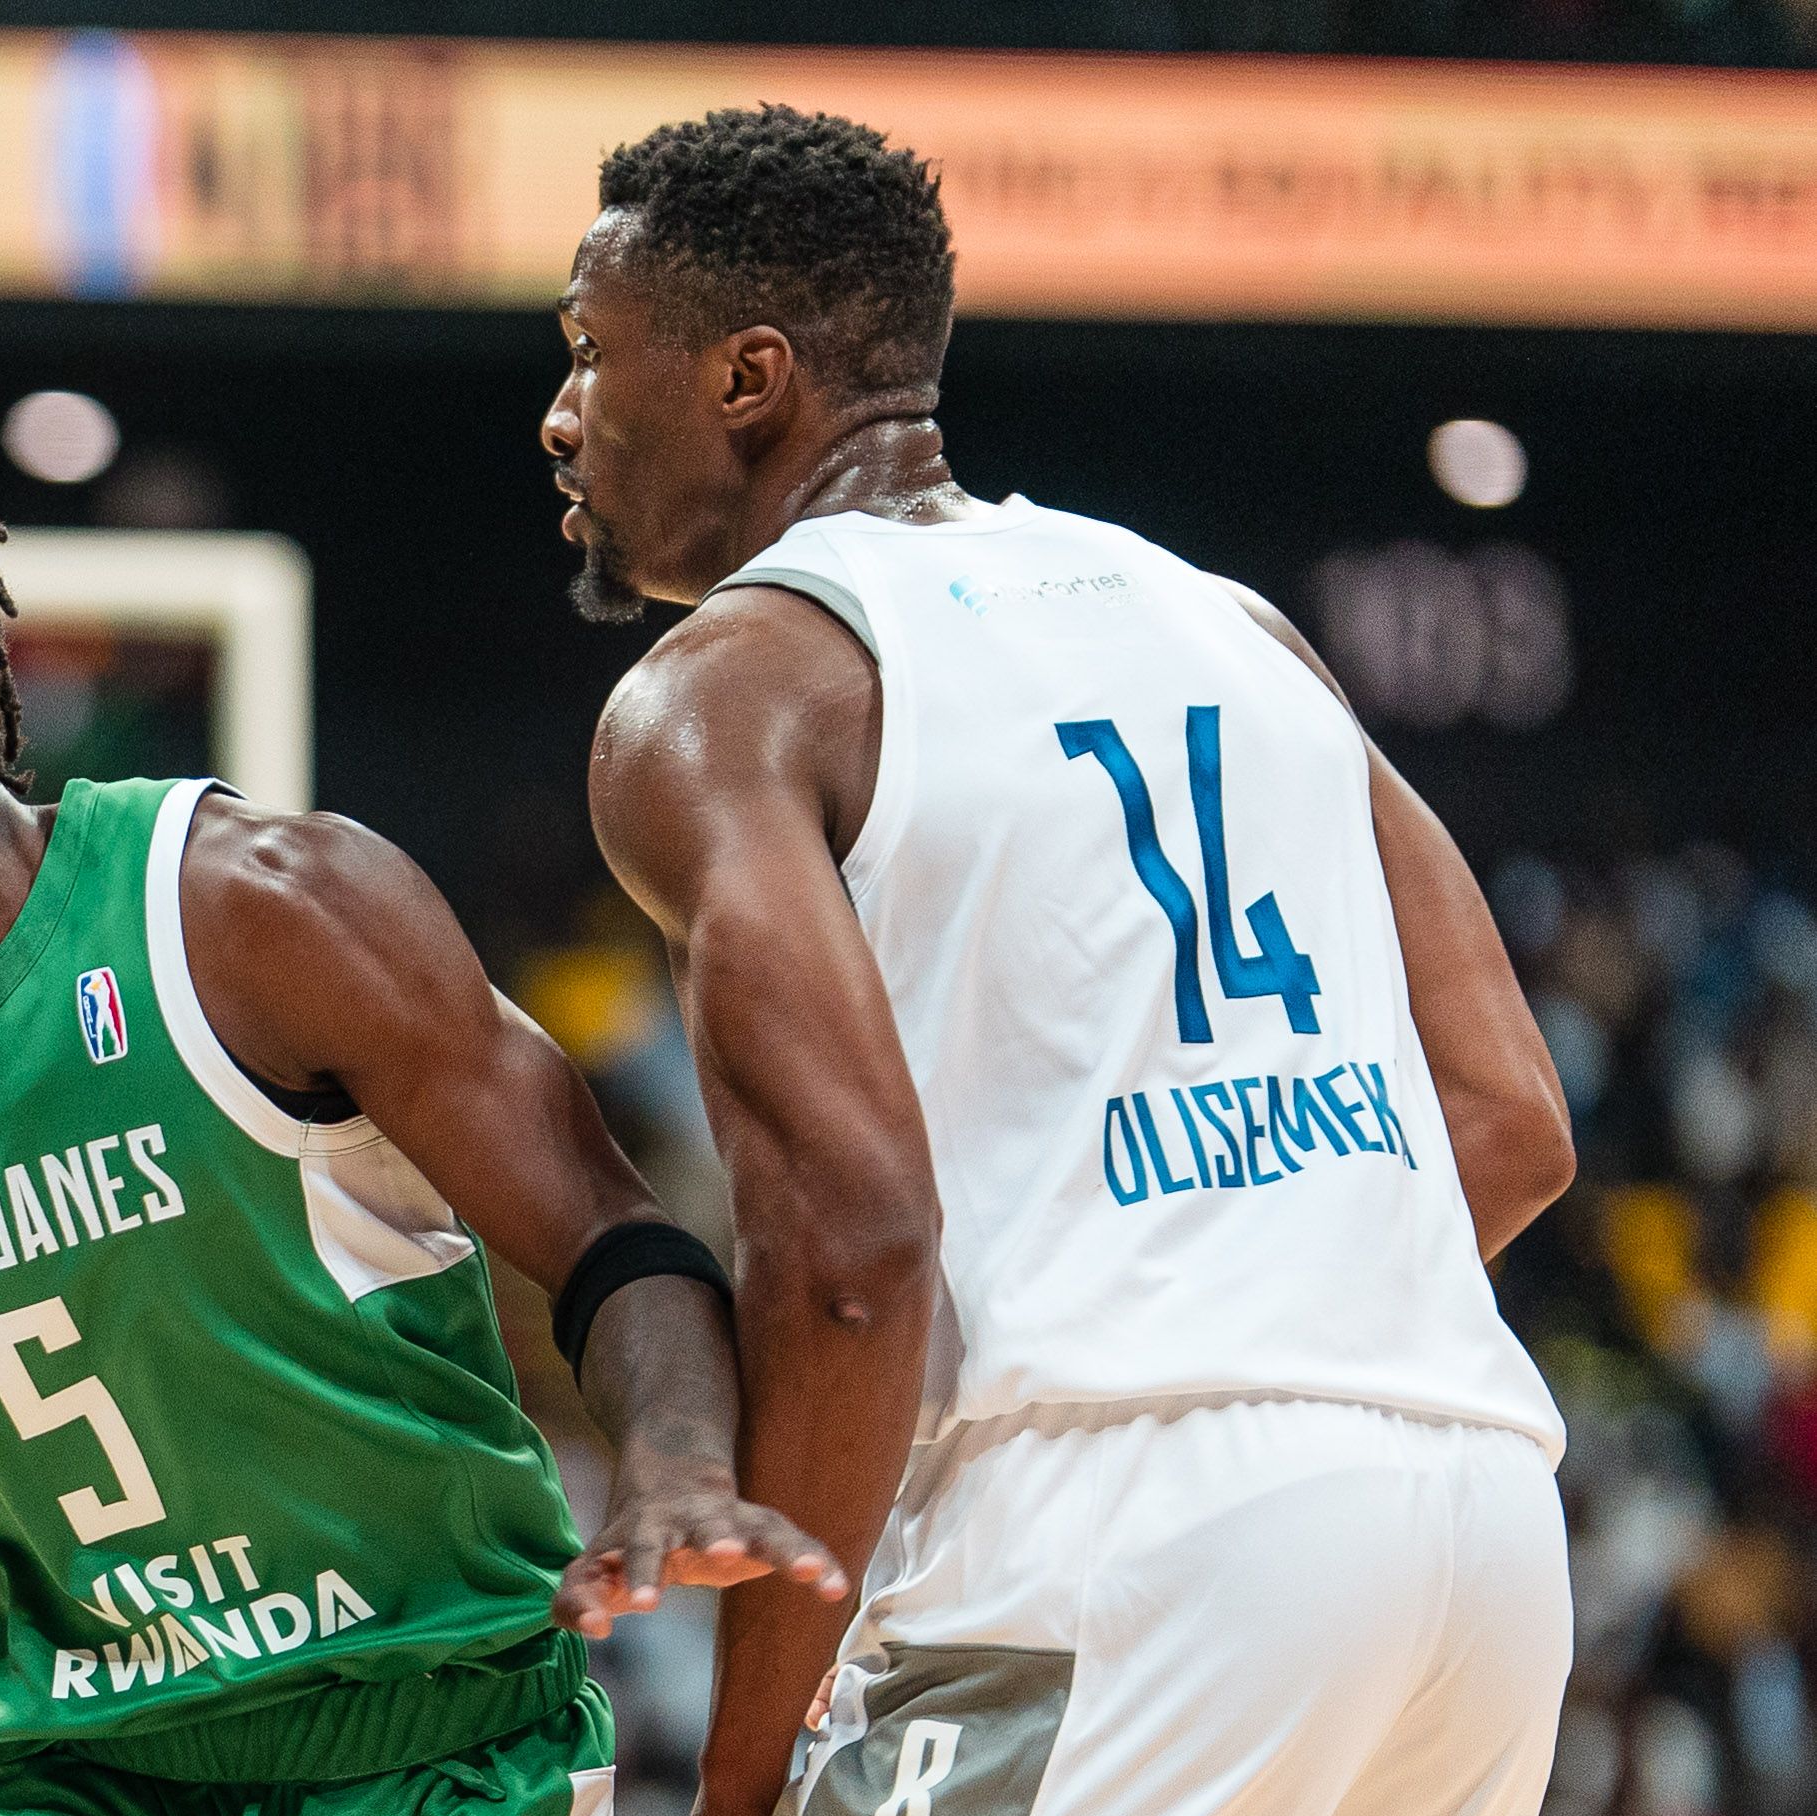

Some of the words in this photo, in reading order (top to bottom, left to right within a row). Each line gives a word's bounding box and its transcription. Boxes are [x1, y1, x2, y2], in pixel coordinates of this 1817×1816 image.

[1054, 705, 1322, 1044] 14
[1104, 1061, 1419, 1207] OLISEMEK
[52, 1568, 377, 1699] RWANDA
[76, 1534, 261, 1628] VISIT
